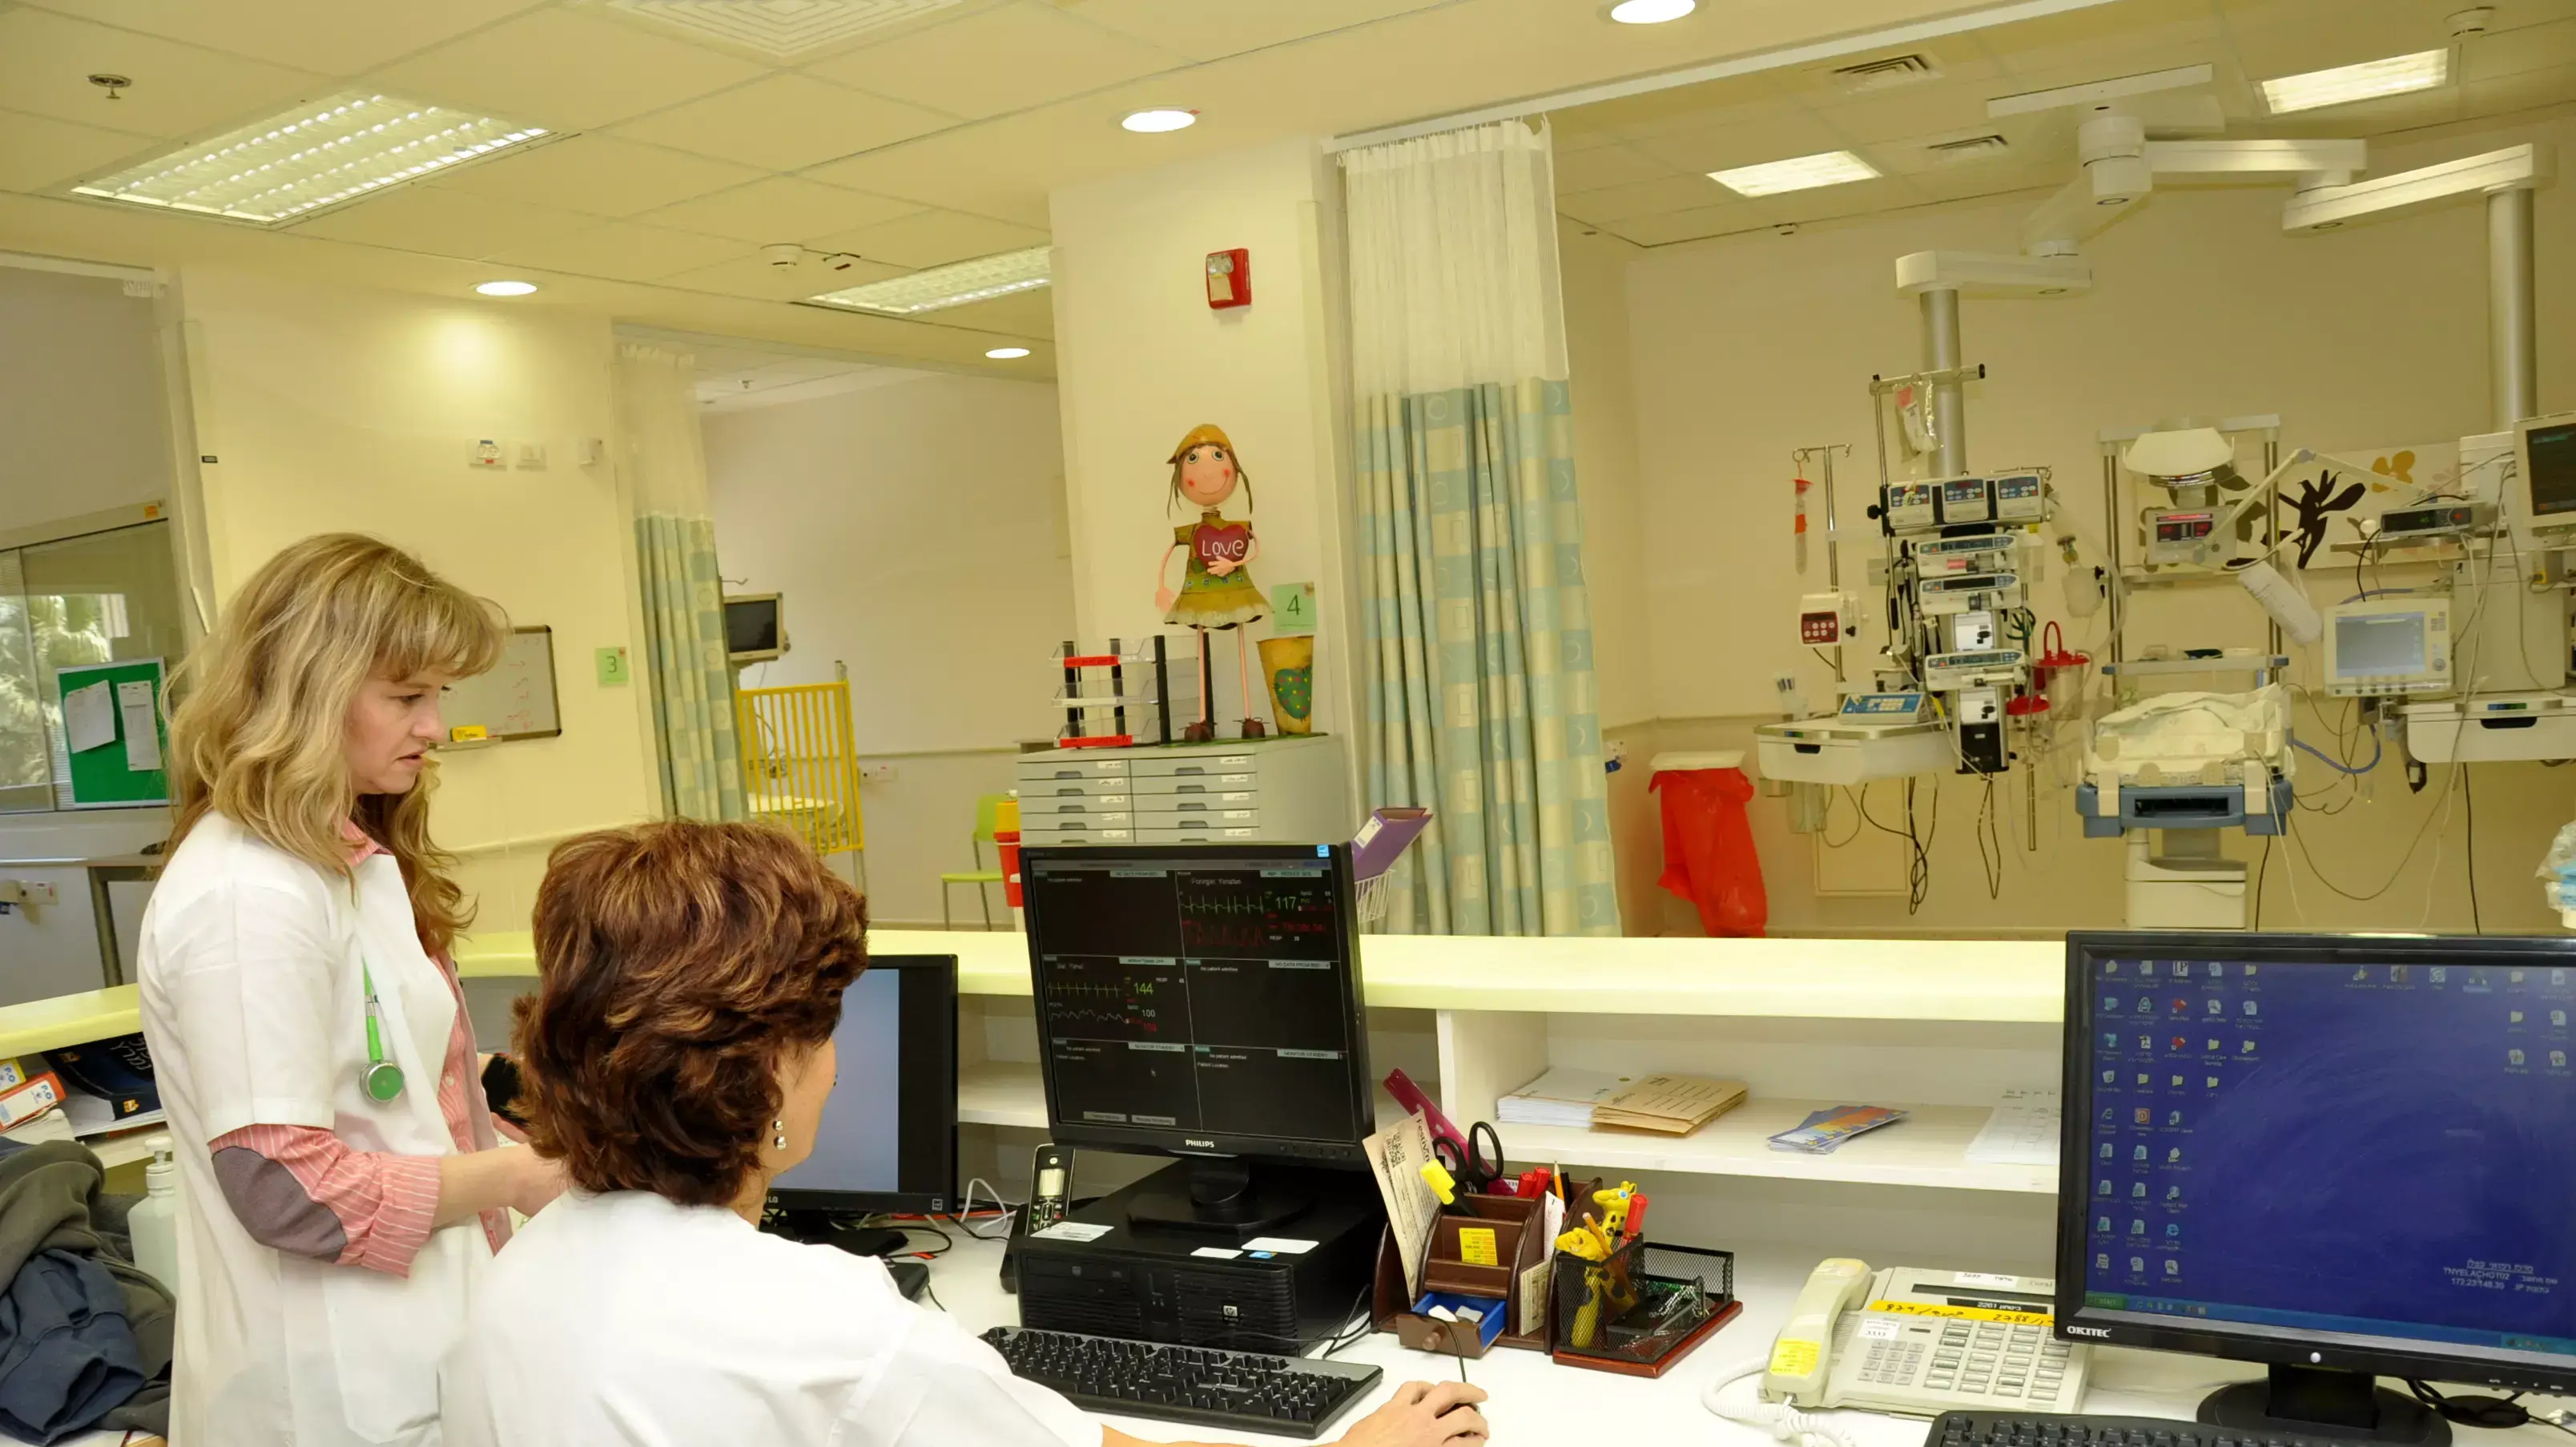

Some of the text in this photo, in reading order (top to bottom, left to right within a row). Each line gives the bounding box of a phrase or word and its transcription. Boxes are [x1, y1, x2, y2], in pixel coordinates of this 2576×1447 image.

[1202, 539, 1244, 556] Love
[1286, 594, 1301, 616] 4
[606, 655, 618, 674] 3
[1275, 896, 1296, 910] 117
[1133, 982, 1154, 995] 144
[1141, 1009, 1156, 1018] 100
[1185, 1139, 1214, 1148] PHILIPS
[2067, 1325, 2111, 1338] OKITEC
